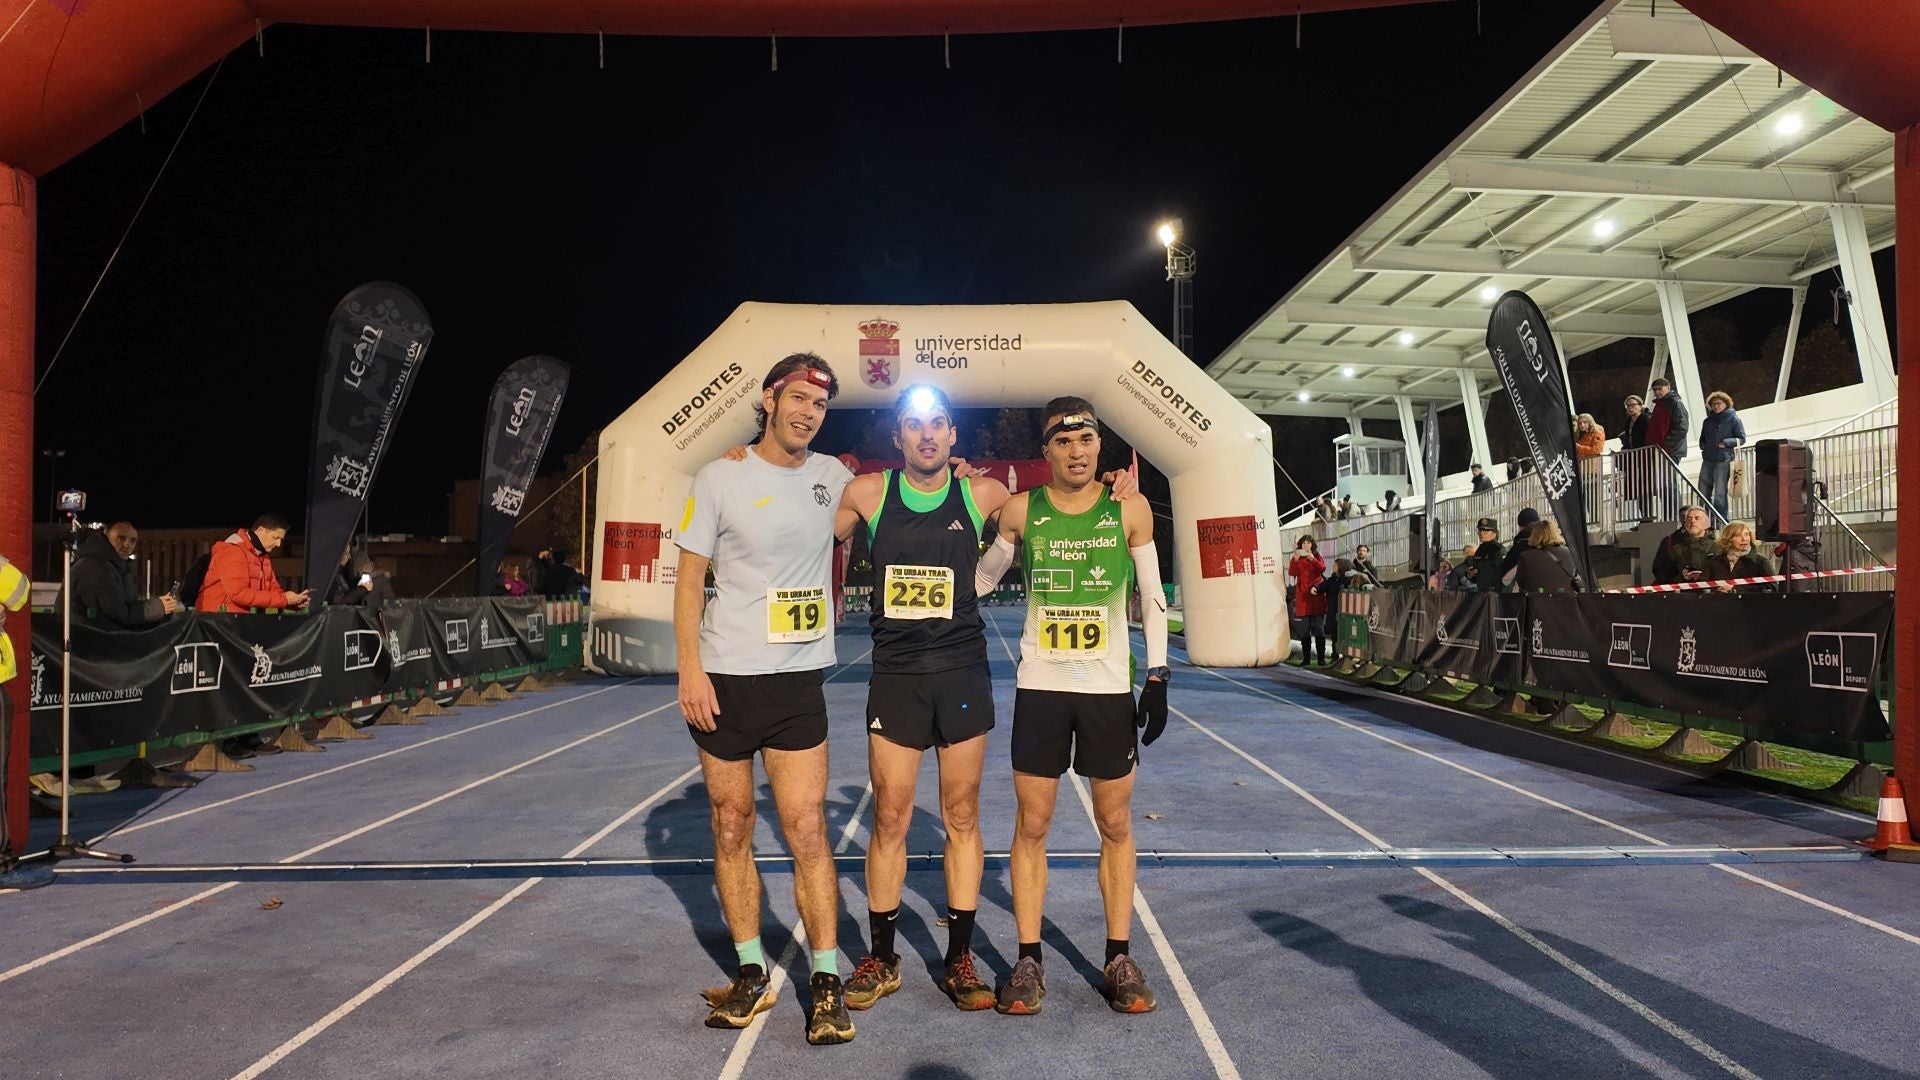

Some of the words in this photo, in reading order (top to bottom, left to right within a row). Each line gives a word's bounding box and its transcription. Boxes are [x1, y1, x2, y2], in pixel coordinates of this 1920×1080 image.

[915, 334, 1022, 350] universidad
[915, 351, 930, 363] de
[930, 351, 968, 369] león
[368, 384, 401, 465] AYUNTAMIENTO
[398, 368, 409, 386] DE
[405, 340, 419, 369] LEÓN
[662, 362, 743, 436] DEPORTES
[1131, 360, 1212, 432] DEPORTES
[675, 406, 726, 451] Universidad
[724, 397, 737, 409] de
[735, 377, 759, 399] León
[1117, 374, 1167, 419] Universidad
[1164, 416, 1177, 429] de
[1176, 426, 1199, 448] León
[604, 525, 672, 540] universidad
[1199, 518, 1265, 535] universidad
[1049, 536, 1117, 549] universidad
[1208, 533, 1235, 546] león
[1049, 549, 1061, 557] de
[1061, 550, 1087, 561] león
[892, 568, 903, 576] VIII
[904, 569, 927, 577] URBAN
[928, 570, 948, 578] TRAIL
[777, 591, 788, 599] VIII
[790, 590, 812, 599] URBAN
[891, 582, 946, 608] 226
[786, 603, 819, 631] 19
[1057, 609, 1080, 617] URBAN
[1081, 609, 1101, 617] TRAIL
[1045, 623, 1101, 650] 119
[174, 658, 193, 675] LEÓN
[1812, 649, 1839, 667] LEÓN
[1694, 664, 1738, 676] AYUNTAMIENTO
[1738, 667, 1748, 677] DE
[1748, 667, 1767, 678] LEÓN
[1845, 666, 1852, 674] ES
[1845, 675, 1867, 684] DEPORTE
[43, 691, 113, 704] AYUTAMIENTO
[114, 690, 125, 699] DE
[125, 686, 143, 698] LEÓN
